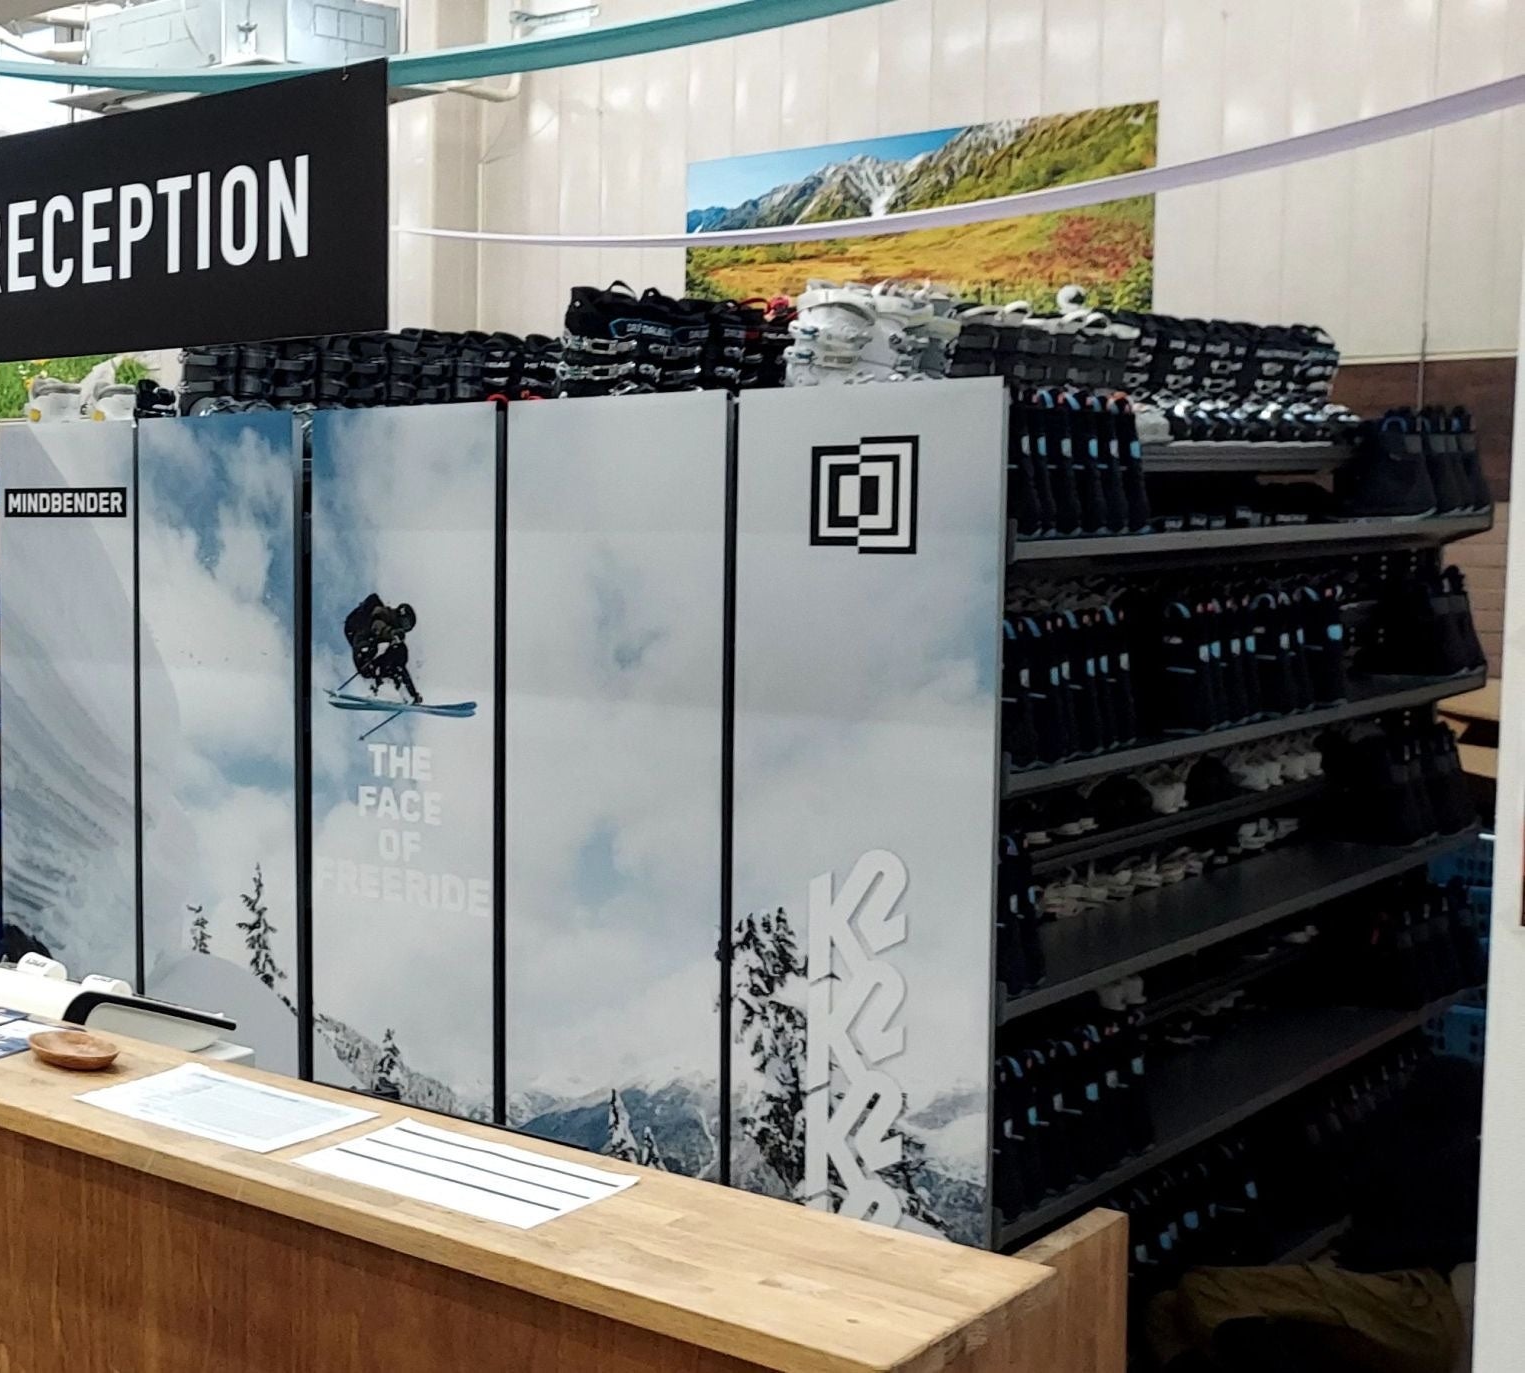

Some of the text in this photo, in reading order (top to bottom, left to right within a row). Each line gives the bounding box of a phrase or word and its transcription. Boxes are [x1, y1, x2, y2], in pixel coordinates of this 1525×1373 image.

[7, 490, 124, 516] MINDBENDER
[367, 743, 433, 782] THE
[356, 785, 442, 826] FACE
[378, 828, 422, 863] OF
[315, 855, 491, 918] FREERIDE
